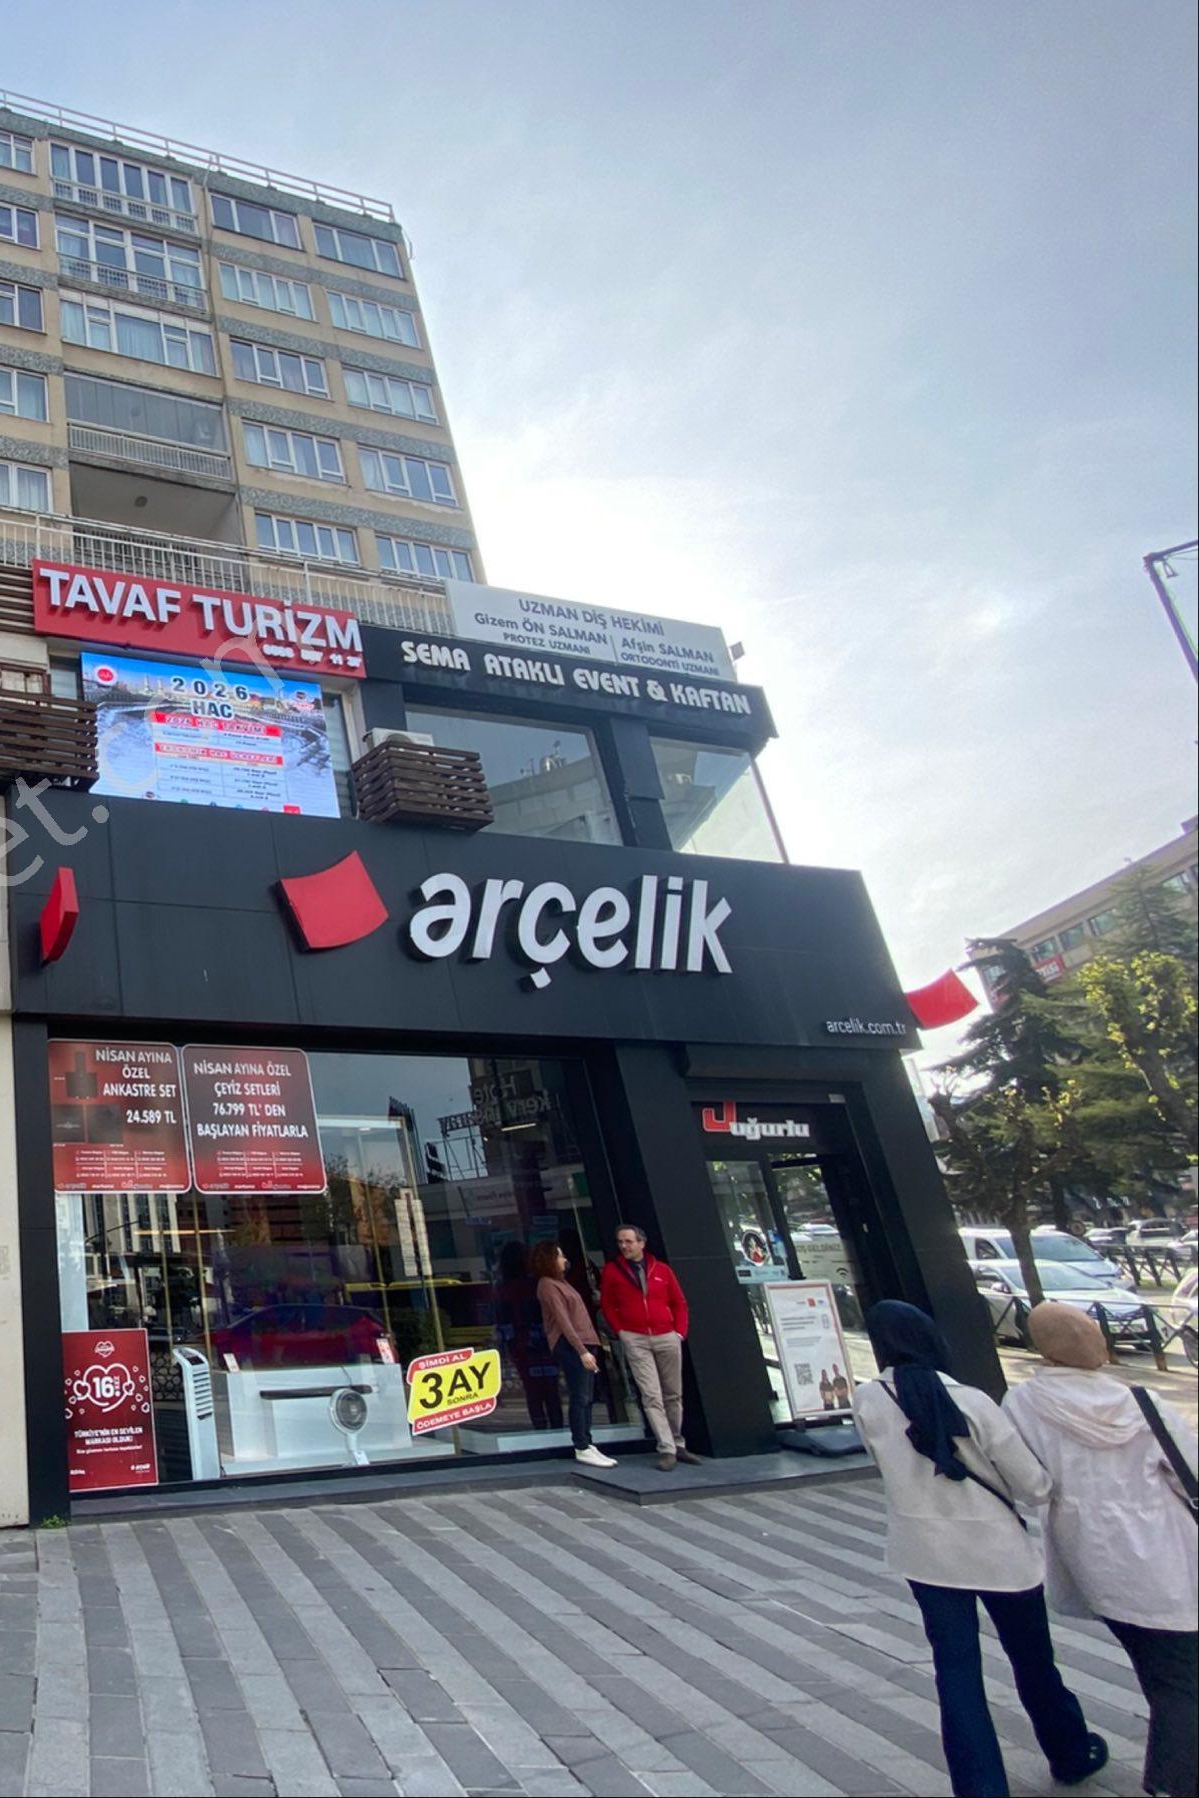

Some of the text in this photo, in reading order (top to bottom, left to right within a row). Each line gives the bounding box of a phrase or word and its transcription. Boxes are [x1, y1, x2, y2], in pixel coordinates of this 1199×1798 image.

[39, 567, 363, 652] TAVAF TURİZM
[518, 599, 664, 637] UZMAN DİŞ HEKİMİ
[474, 612, 608, 646] Gizem ÖN SALMAN
[502, 632, 591, 655] PROTEZ UZMANI
[621, 636, 714, 663] Afşin SALMAN
[401, 640, 751, 715] SEMA ATAKLI EVENT & KAFTAN
[683, 662, 720, 676] UZMANI
[170, 676, 250, 701] 2026
[192, 701, 234, 719] HAC
[409, 873, 733, 989] arçelik
[826, 1018, 907, 1035] arcelik.com.tr
[95, 1048, 172, 1064] NİSAN AYINA
[122, 1065, 150, 1079] ÖZEL
[193, 1060, 291, 1077] NİSAN AYINA ÖZEL
[103, 1083, 176, 1098] ANKASTRE SET
[214, 1079, 281, 1098] ÇEYİZ SETLERİ
[126, 1110, 177, 1124] 24.589 TL
[212, 1102, 244, 1115] 76.799
[265, 1102, 286, 1116] DEN
[197, 1121, 308, 1139] BAŞLAYAN FİYATLARLA
[418, 1354, 466, 1369] ŞİMDİ AL
[419, 1362, 491, 1409] 3 AY
[447, 1392, 479, 1405] SONRA
[416, 1402, 492, 1430] ÖDEMEYE BAŞLA
